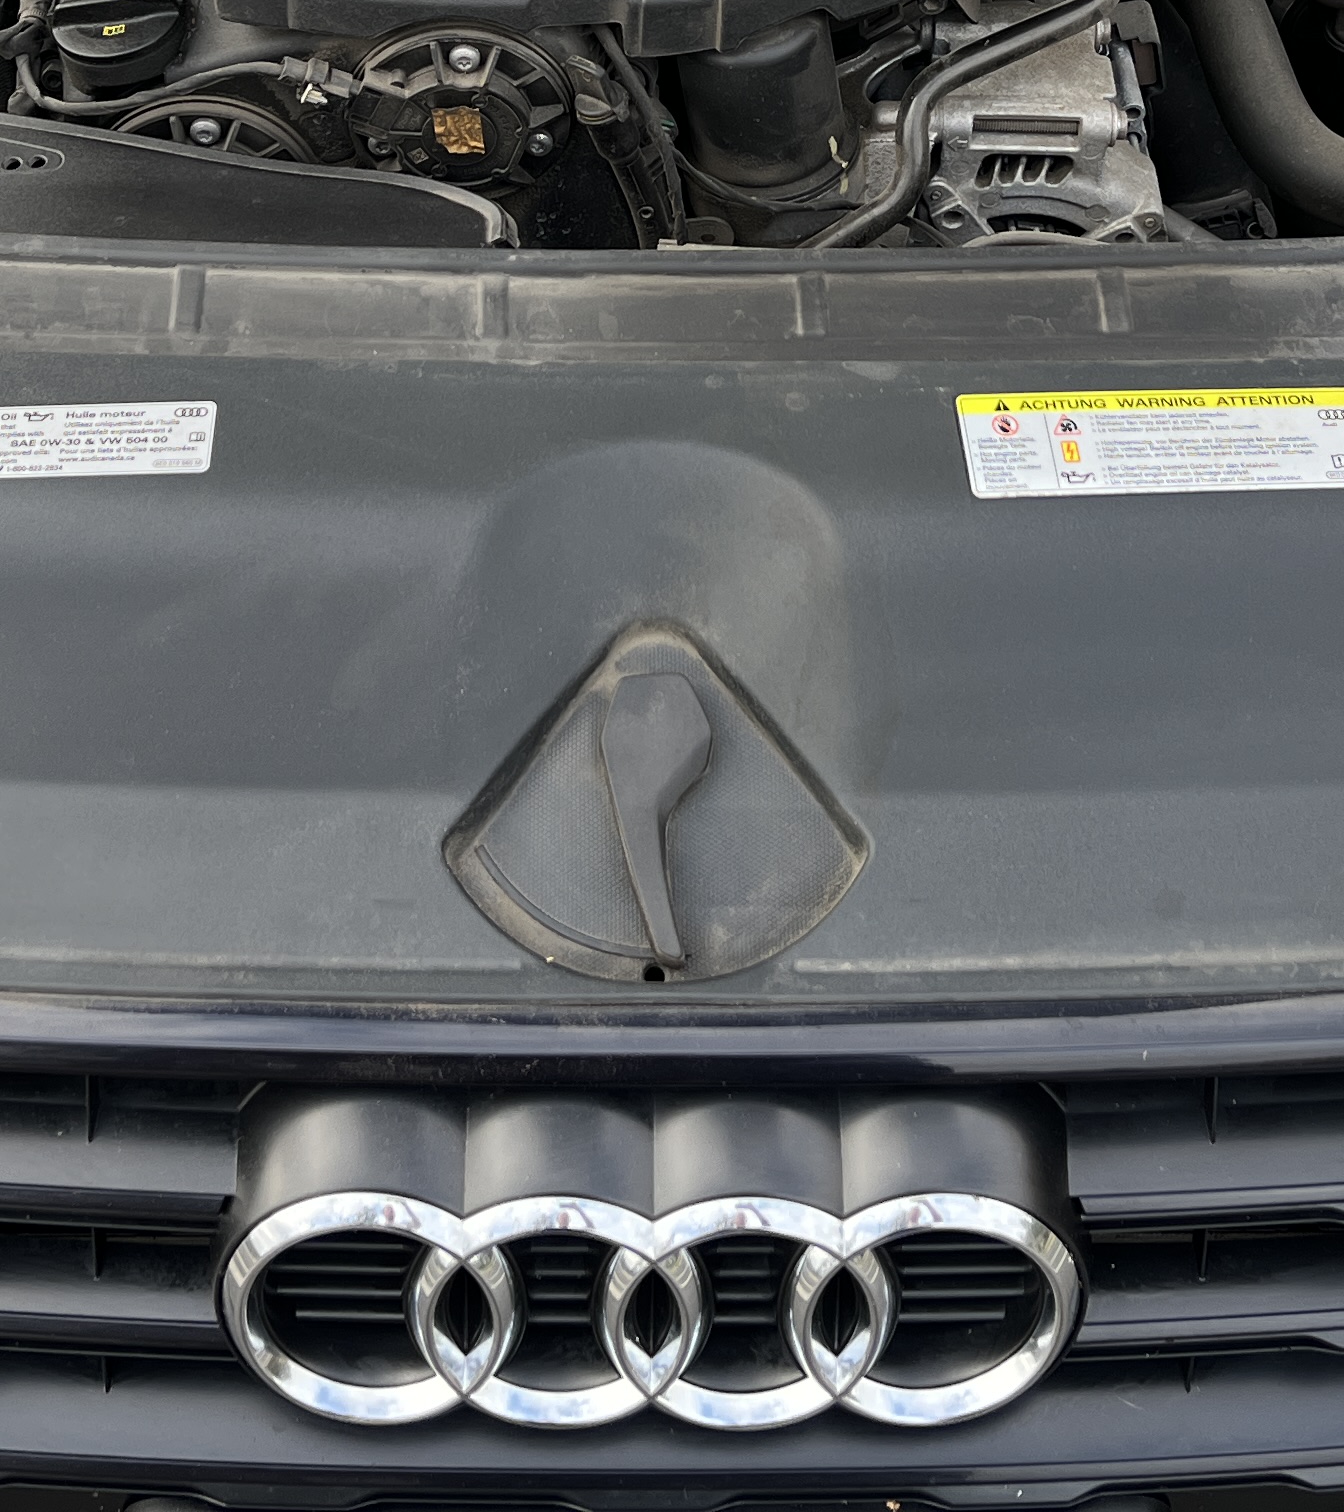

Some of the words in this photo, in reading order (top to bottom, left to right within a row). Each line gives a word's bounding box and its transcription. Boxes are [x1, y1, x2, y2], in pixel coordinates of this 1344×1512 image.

[1019, 398, 1107, 411] ACHTUNG
[1115, 396, 1207, 409] WARNING
[1216, 394, 1316, 407] ATTENTION
[1, 412, 17, 422] Oil
[65, 410, 97, 419] Huile
[99, 409, 147, 419] moteur
[10, 438, 37, 448] SAE
[39, 437, 81, 448] 0W-30
[84, 437, 96, 447] &
[99, 436, 124, 446] VW
[125, 435, 150, 445] 504
[152, 434, 169, 444] 00
